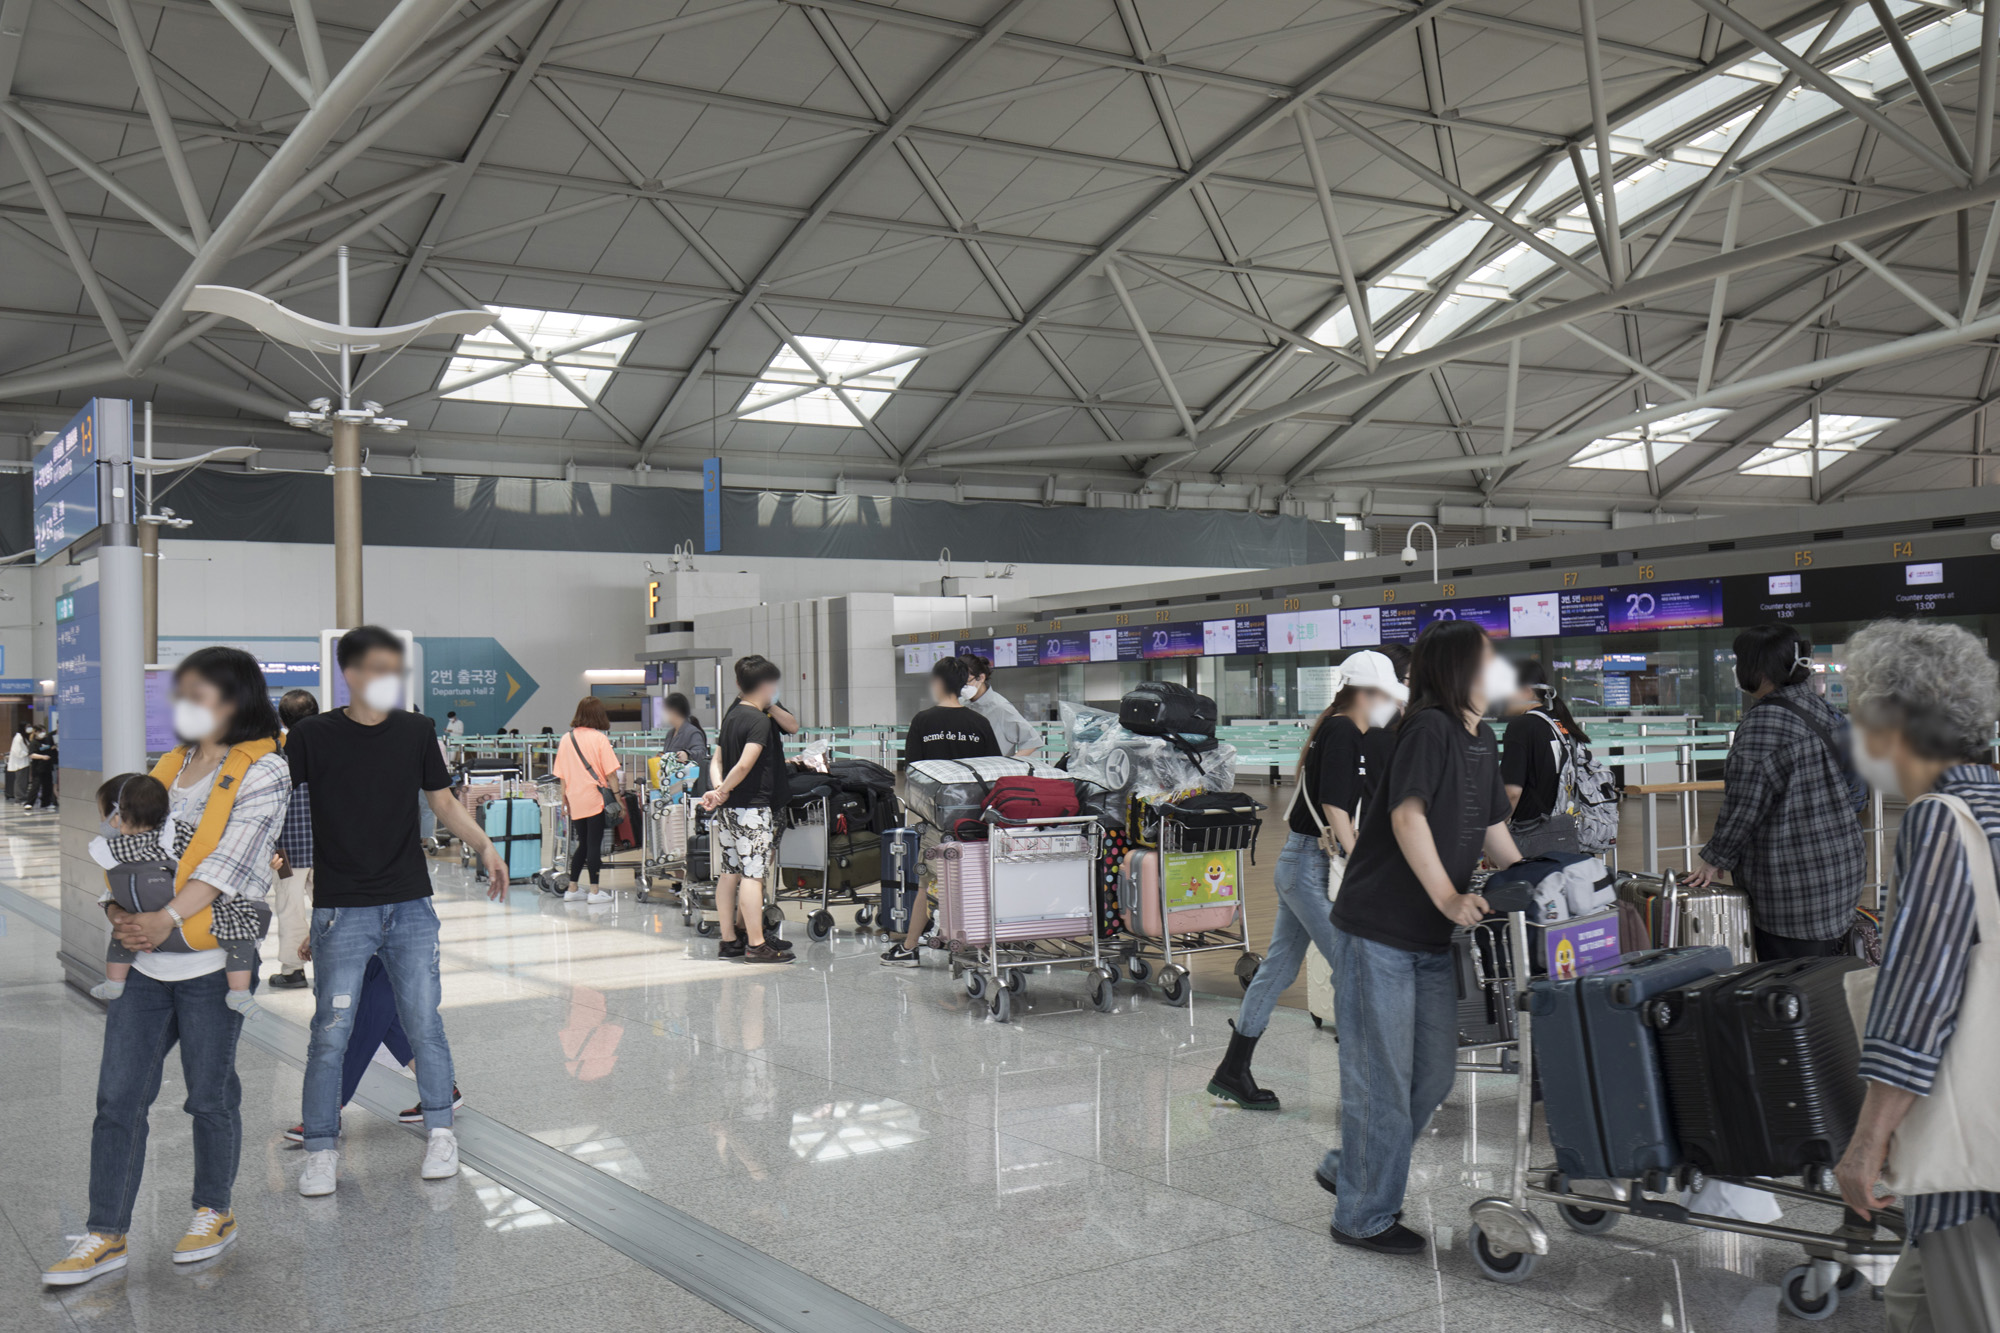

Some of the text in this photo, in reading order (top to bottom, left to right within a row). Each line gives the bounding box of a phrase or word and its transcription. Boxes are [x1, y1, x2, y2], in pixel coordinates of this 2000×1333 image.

[81, 416, 92, 456] 1-3
[707, 470, 716, 492] 3
[1893, 541, 1912, 558] F4
[1794, 551, 1813, 567] F5
[1564, 572, 1578, 586] F7
[1639, 565, 1654, 580] F6
[1383, 589, 1395, 602] F9
[1442, 584, 1455, 597] F8
[1896, 593, 1923, 602] Counter
[1924, 592, 1946, 602] opens
[649, 581, 659, 618] F
[1283, 598, 1299, 611] F10
[1626, 593, 1656, 617] 20
[1915, 602, 1936, 610] 13:00
[1235, 603, 1249, 615] F11
[1760, 603, 1784, 611] Counter
[1785, 602, 1804, 611] opens
[1116, 614, 1129, 625] F13
[1156, 610, 1170, 621] F12
[1777, 610, 1794, 619] 13:00
[1016, 624, 1027, 634] F15
[1050, 621, 1061, 631] F14
[930, 632, 940, 641] F17
[960, 629, 969, 639] F16
[1152, 630, 1169, 648] 20
[1047, 639, 1061, 655] 20
[430, 669, 498, 685] 2번 출국장
[432, 687, 495, 696] Departure Hall 2
[946, 730, 957, 741] de
[957, 731, 967, 741] la
[968, 732, 980, 743] vie
